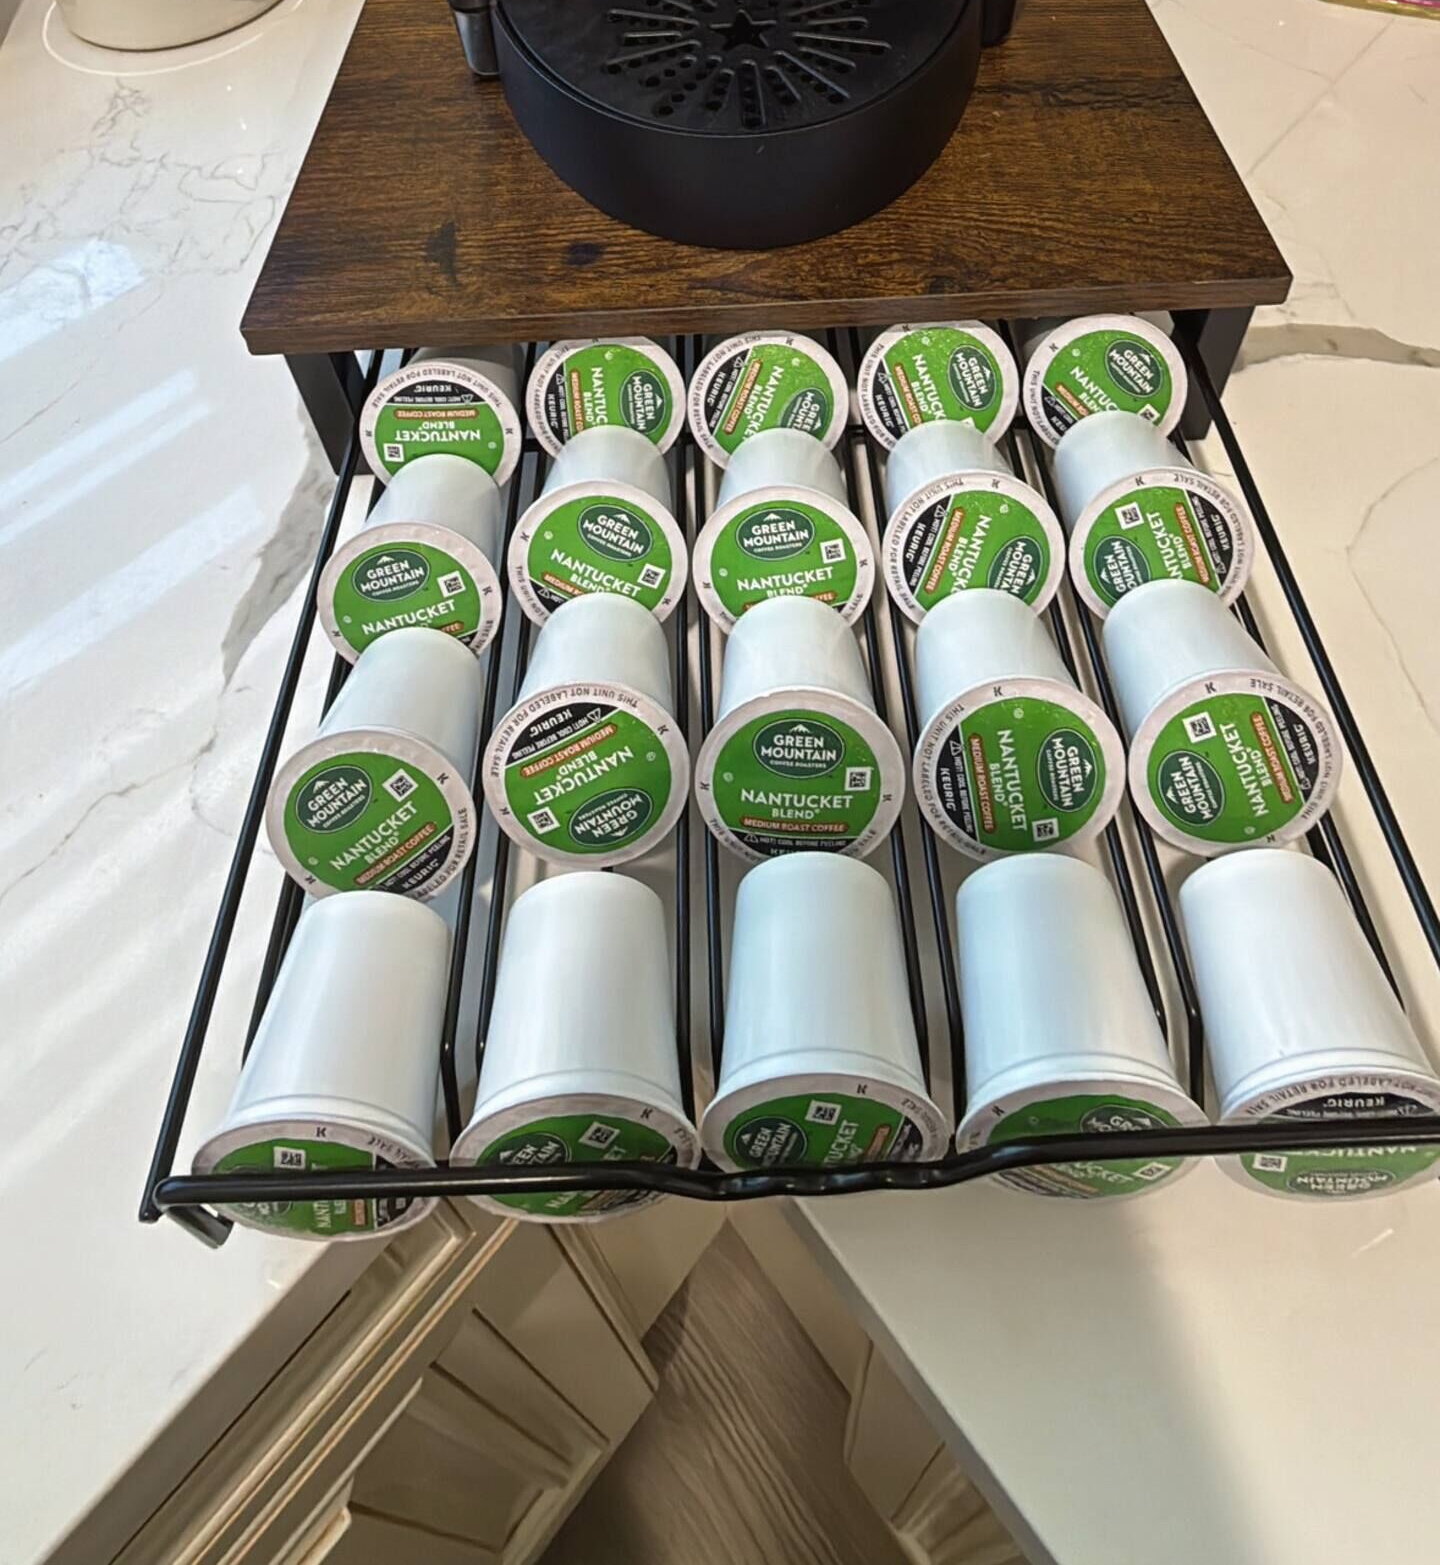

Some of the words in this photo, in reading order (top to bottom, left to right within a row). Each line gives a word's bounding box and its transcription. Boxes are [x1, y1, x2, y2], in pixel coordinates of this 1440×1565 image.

[956, 352, 982, 407] MOUNTAIN
[968, 357, 988, 394] GREEN
[1109, 348, 1154, 394] MOUNTAIN
[1123, 349, 1154, 380] GREEN
[414, 385, 452, 393] KEURIG
[591, 367, 608, 425] NANTUC
[632, 376, 647, 431] MOUNTAIN
[643, 383, 656, 420] GREEN
[706, 371, 726, 405] KEURIG
[743, 384, 763, 415] BLEND
[743, 366, 784, 439] NANTUCKE
[911, 354, 946, 420] NANTUCK
[911, 381, 929, 412] BLEND
[1070, 366, 1119, 411] NANTUC
[583, 391, 594, 422] BLEND
[803, 403, 820, 431] GREE
[875, 394, 894, 429] KEURIG
[395, 429, 481, 442] NANTUCKET
[422, 421, 455, 430] BLEND
[583, 519, 644, 555] MOUNTAIN
[597, 514, 639, 540] GREEN
[742, 529, 810, 548] MOUNTAIN
[751, 520, 796, 536] GREEN
[906, 522, 927, 564] KEURIG
[1210, 514, 1230, 551] KEURIG
[366, 559, 411, 580] GREEN
[948, 537, 969, 571] BLEND
[952, 515, 992, 592] NANTUCK
[1001, 541, 1027, 589] MOUNTA
[1111, 540, 1138, 588] OUNTAIN
[1173, 536, 1192, 570] BLEND
[360, 567, 425, 593] MOUNTAIN
[550, 548, 643, 598] NANTUCKET
[737, 566, 834, 592] NANTUCKET
[1010, 554, 1033, 594] GREEN
[1104, 555, 1126, 593] GREEN
[766, 587, 804, 598] BLEND
[361, 599, 455, 636] NANTUCKET
[529, 690, 568, 713] LABELED
[569, 688, 590, 697] NOT
[593, 688, 616, 699] UNIT
[618, 695, 639, 709] THIS
[512, 708, 529, 727] FOR
[529, 708, 573, 738] KEURIG
[499, 726, 515, 754] RETAIL
[554, 741, 581, 758] ROAST
[580, 725, 614, 745] MEDIUM
[773, 734, 825, 749] GREEN
[1293, 723, 1317, 765] KEURIG
[491, 753, 501, 778] SALE
[523, 753, 555, 776] COFFEE
[558, 750, 598, 776] BLEND
[760, 746, 837, 762] MOUNTAIN
[769, 759, 794, 767] COFFEE
[970, 738, 984, 774] MEDIUM
[1067, 745, 1085, 793] GREEN
[1219, 723, 1270, 817] NANTUCKET
[1250, 750, 1273, 787] BLEND
[533, 746, 634, 806] NANTUCKET
[989, 762, 1005, 803] BLEND
[996, 729, 1028, 831] NANTUCKET
[1051, 737, 1074, 807] MOUNTAIN
[1178, 756, 1214, 820] MOUNTAIN
[307, 777, 349, 812] GREEN
[307, 779, 368, 828] MOUNTAIN
[740, 788, 854, 809] NANTUCKET
[940, 767, 957, 812] KEURIG
[1171, 771, 1197, 814] GREEN
[574, 794, 644, 835] MOUNTAIN
[591, 810, 638, 838] GREEN
[743, 818, 781, 830] MEDIUM
[781, 822, 811, 832] ROAST
[811, 824, 845, 833] COFFEE
[771, 808, 815, 821] BLEND
[330, 800, 418, 871] NANTUCKET
[364, 836, 400, 864] BLEND
[356, 861, 385, 885] MEDIUM
[384, 846, 409, 867] ROAST
[405, 825, 435, 851] COFFEE
[402, 858, 440, 889] KEURIG
[1326, 1094, 1385, 1108] KEURIG
[750, 1126, 773, 1158] GREEN
[824, 1119, 859, 1164] TUCKET
